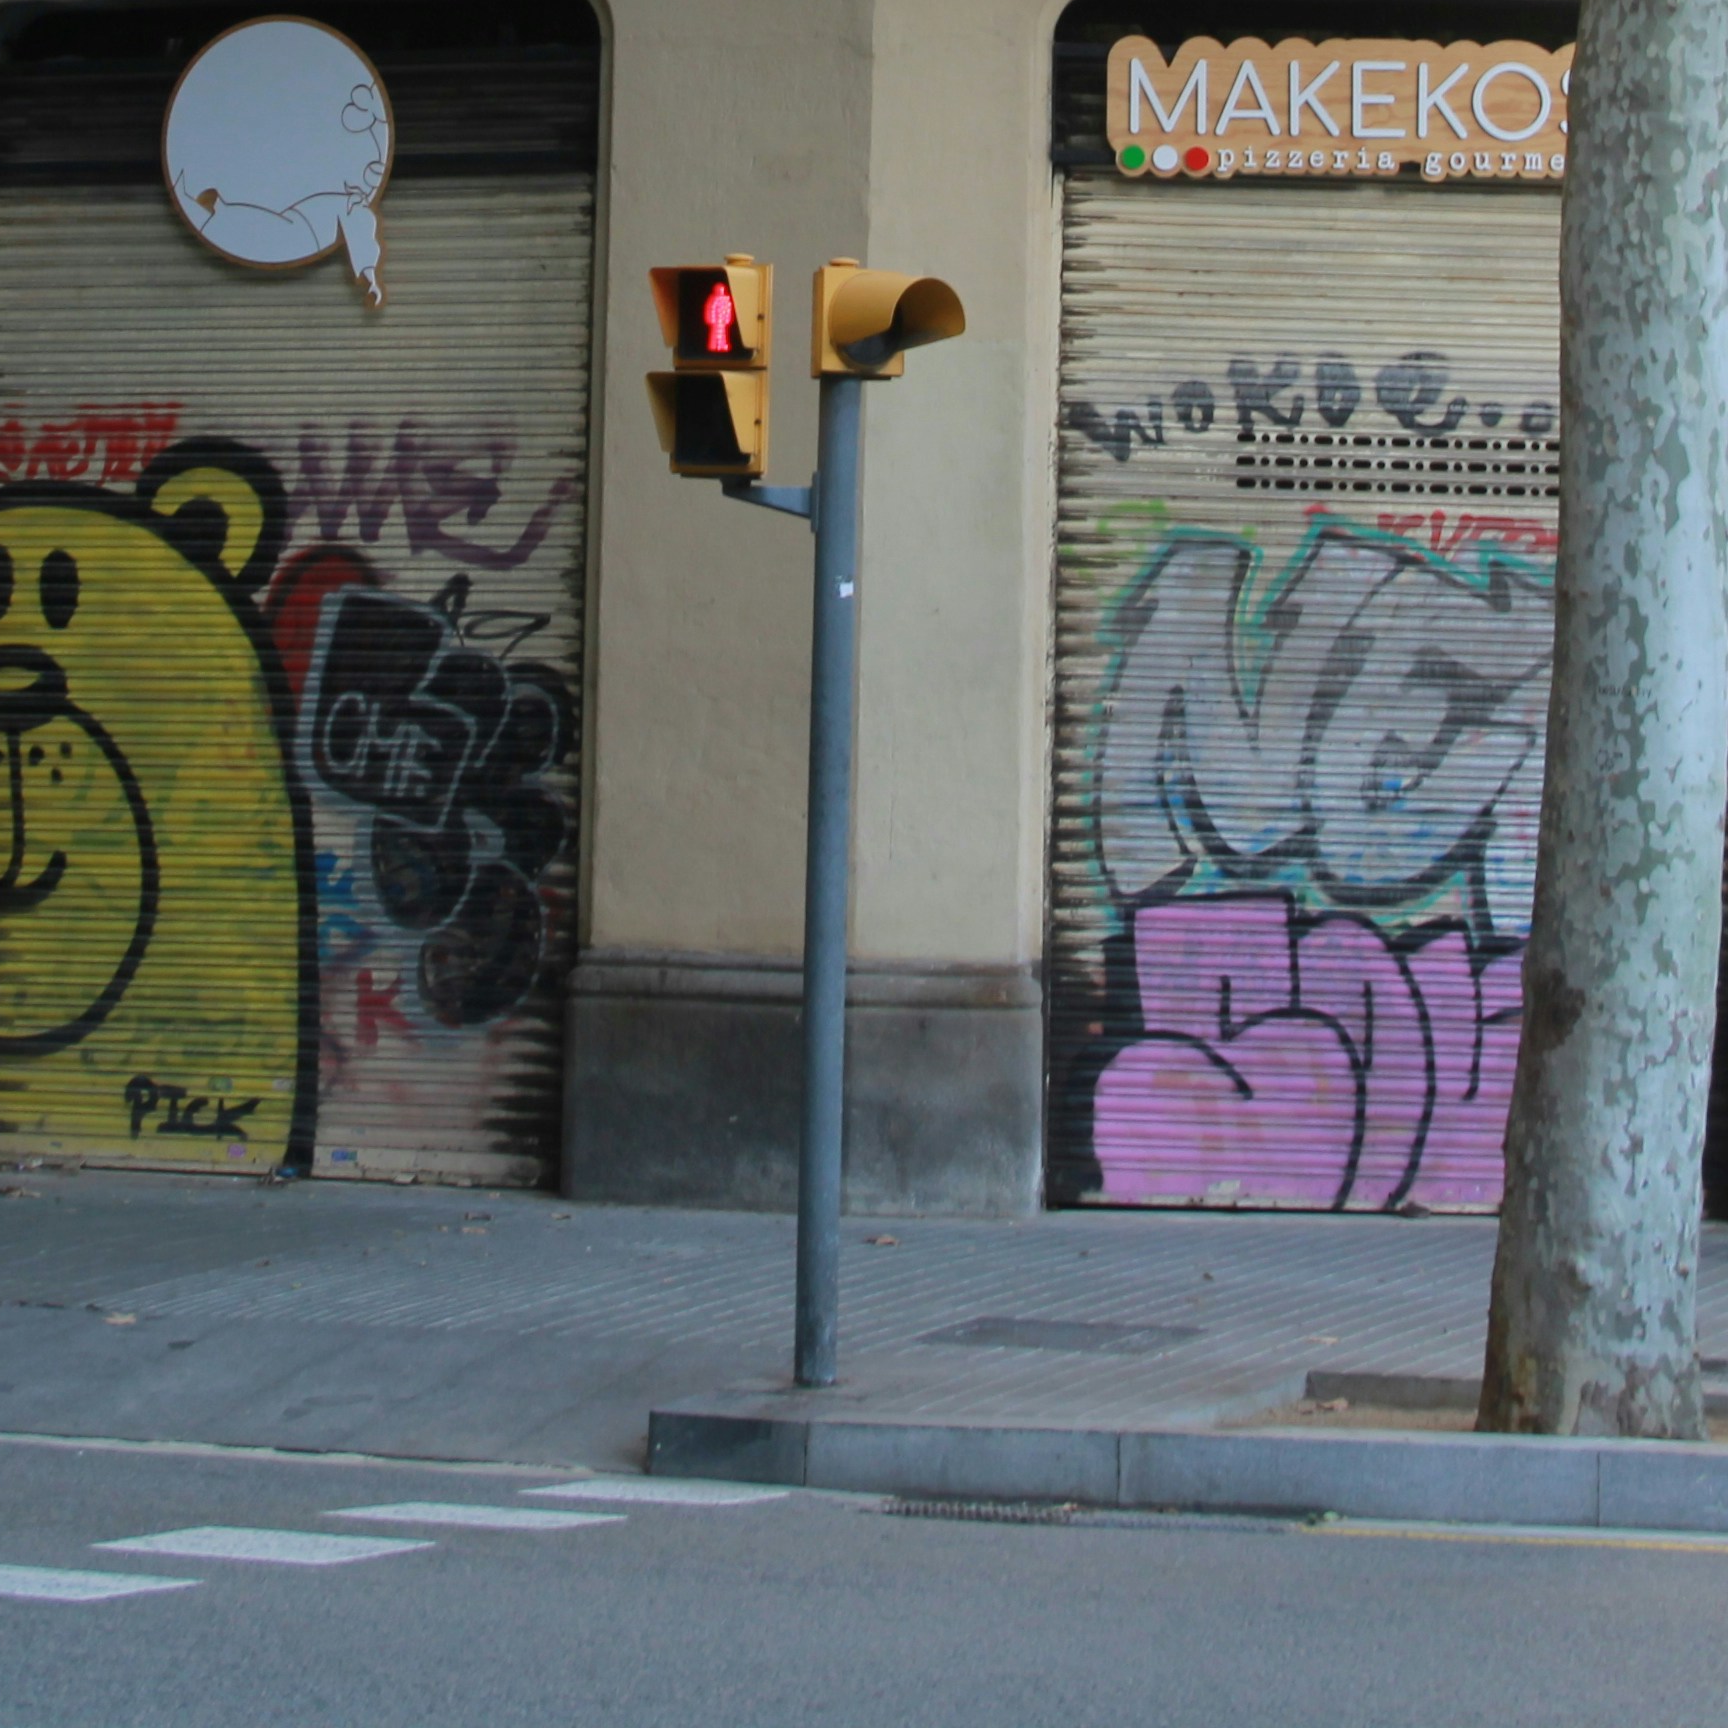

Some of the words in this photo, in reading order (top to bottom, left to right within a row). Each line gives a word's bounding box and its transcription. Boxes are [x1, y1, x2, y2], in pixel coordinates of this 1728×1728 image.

[1128, 58, 1572, 142] MAKEKO
[1215, 146, 1397, 176] pizzeria
[1424, 151, 1565, 176] gourme
[124, 1074, 262, 1142] PICK
